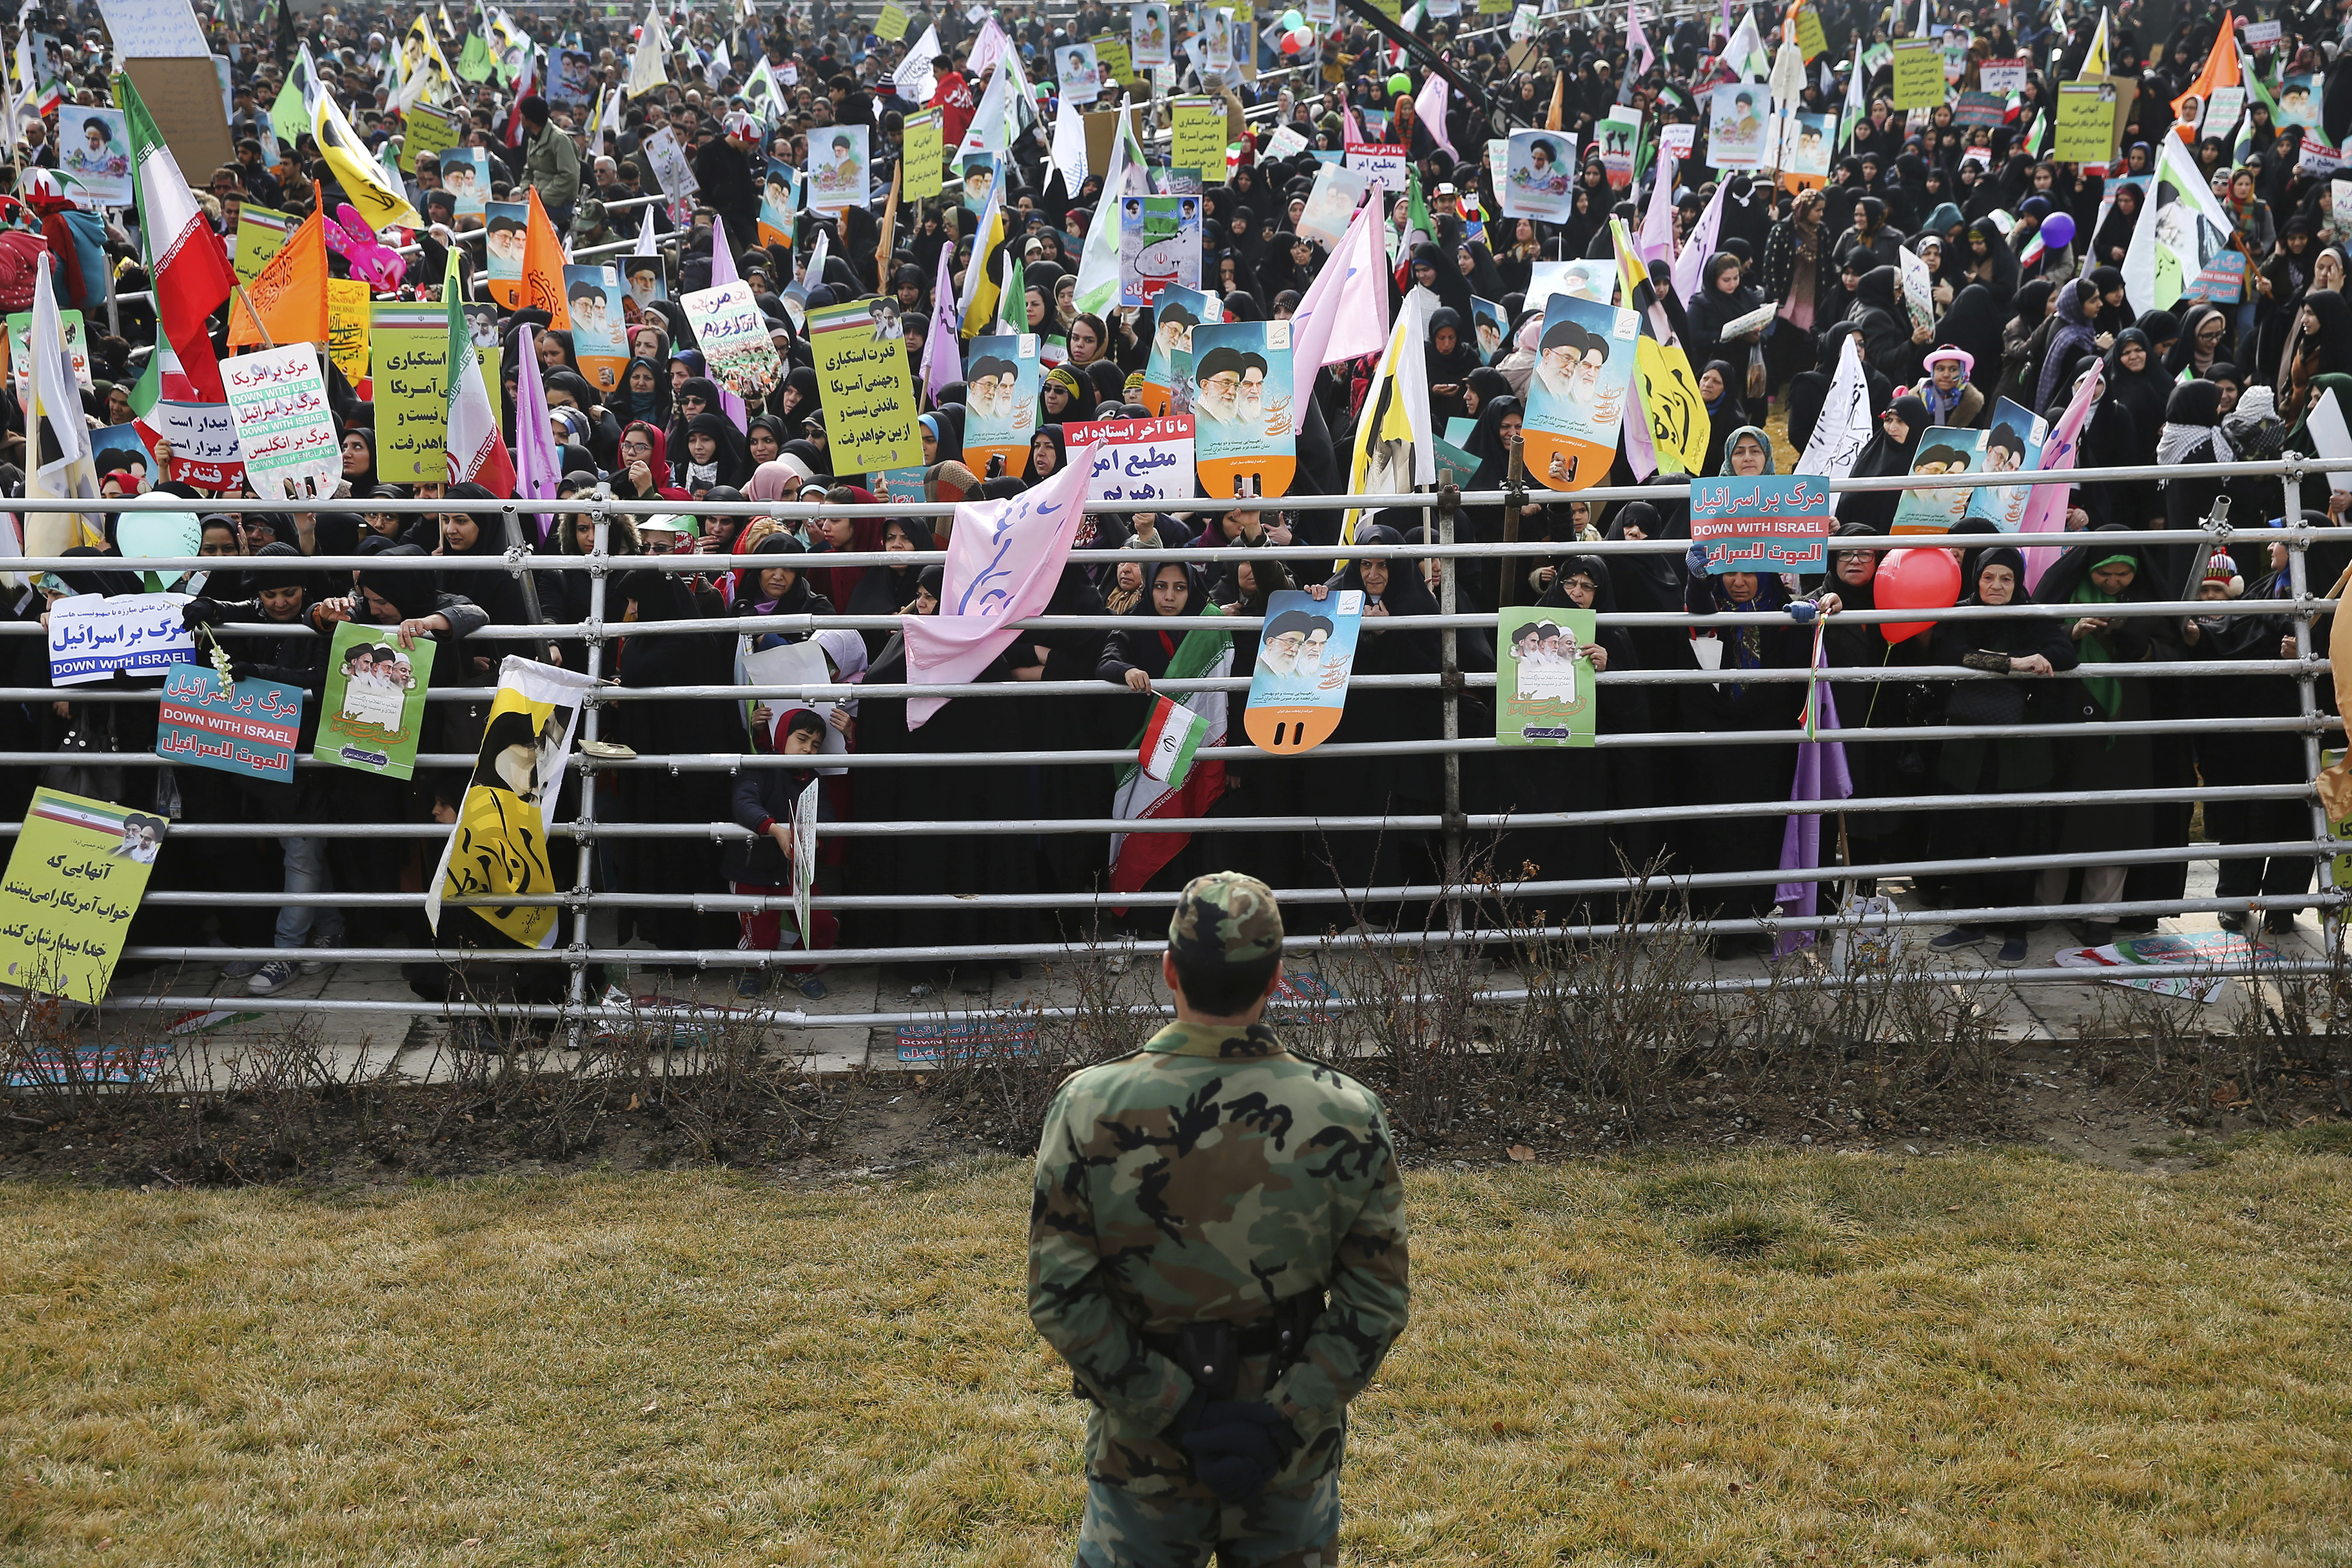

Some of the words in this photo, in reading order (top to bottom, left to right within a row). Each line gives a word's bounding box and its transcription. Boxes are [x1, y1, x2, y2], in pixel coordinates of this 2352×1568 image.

[1357, 158, 1369, 170] امر
[1371, 158, 1396, 172] مطیع
[2221, 254, 2244, 270] مرگ
[2213, 273, 2240, 283] ISRAEL
[706, 292, 731, 315] من
[722, 333, 764, 348] revolutionary
[387, 351, 446, 370] استکباری
[826, 347, 867, 371] استکباری
[869, 342, 895, 363] قدرت
[271, 366, 283, 382] بر
[285, 358, 309, 377] مرگ
[390, 377, 438, 399] آمریکا
[830, 373, 863, 396] آمریکا
[865, 374, 893, 393] جهنمی
[893, 375, 899, 389] و
[233, 392, 263, 404] DOWN
[265, 387, 291, 398] WITH
[292, 381, 318, 393] U.S.A
[296, 392, 320, 411] مرگ
[240, 402, 279, 423] اسرائیل
[283, 402, 293, 416] بر
[406, 406, 439, 424] نیست
[840, 410, 846, 422] و
[846, 401, 868, 418] نیست
[870, 397, 899, 417] ماندنی
[169, 415, 193, 428] است
[198, 416, 228, 432] بیدار
[242, 424, 269, 436] DOWN
[270, 419, 293, 430] WITH
[296, 412, 326, 424] ISRAEL
[397, 411, 405, 426] و
[1165, 420, 1175, 434] تا
[1177, 419, 1188, 433] ما
[306, 427, 330, 446] مرگ
[887, 427, 902, 442] بین
[903, 422, 910, 441] از
[1072, 425, 1088, 443] ایم
[1091, 423, 1134, 440] ایستاده
[1137, 419, 1163, 441] آخر
[169, 437, 191, 450] است
[195, 440, 222, 456] بیزار
[248, 436, 290, 459] انگلیس
[293, 437, 303, 450] بر
[249, 458, 274, 470] DOWN
[275, 453, 295, 464] WITH
[297, 446, 335, 459] ENGLAND
[1091, 449, 1119, 478] امر
[1125, 446, 1177, 477] مطیع
[1693, 485, 1760, 514] اسرائیل
[1759, 492, 1780, 513] بر
[1785, 482, 1825, 511] مرگ
[1694, 523, 1733, 536] DOWN
[1736, 522, 1770, 533] WITH
[1775, 522, 1823, 533] ISRAEL
[1768, 543, 1822, 566] الموت
[77, 609, 111, 618] صهیونیست
[118, 608, 137, 617] مبارزه
[139, 604, 155, 614] عاشق
[53, 624, 123, 651] اسرائیل
[124, 626, 143, 647] بر
[54, 660, 95, 675] DOWN
[99, 656, 134, 669] WITH
[138, 652, 191, 665] ISRAEL
[167, 674, 235, 706] اسرائیل
[232, 694, 254, 715] بر
[259, 690, 298, 720] مرگ
[163, 708, 205, 726] DOWN
[208, 717, 240, 733] WITH
[244, 724, 292, 743] ISRAEL
[236, 747, 289, 771] الموت
[46, 854, 67, 868] که
[62, 861, 115, 881] آنهایی
[60, 890, 102, 914] آمریکا
[97, 902, 131, 923] خواب
[82, 939, 106, 957] خدا
